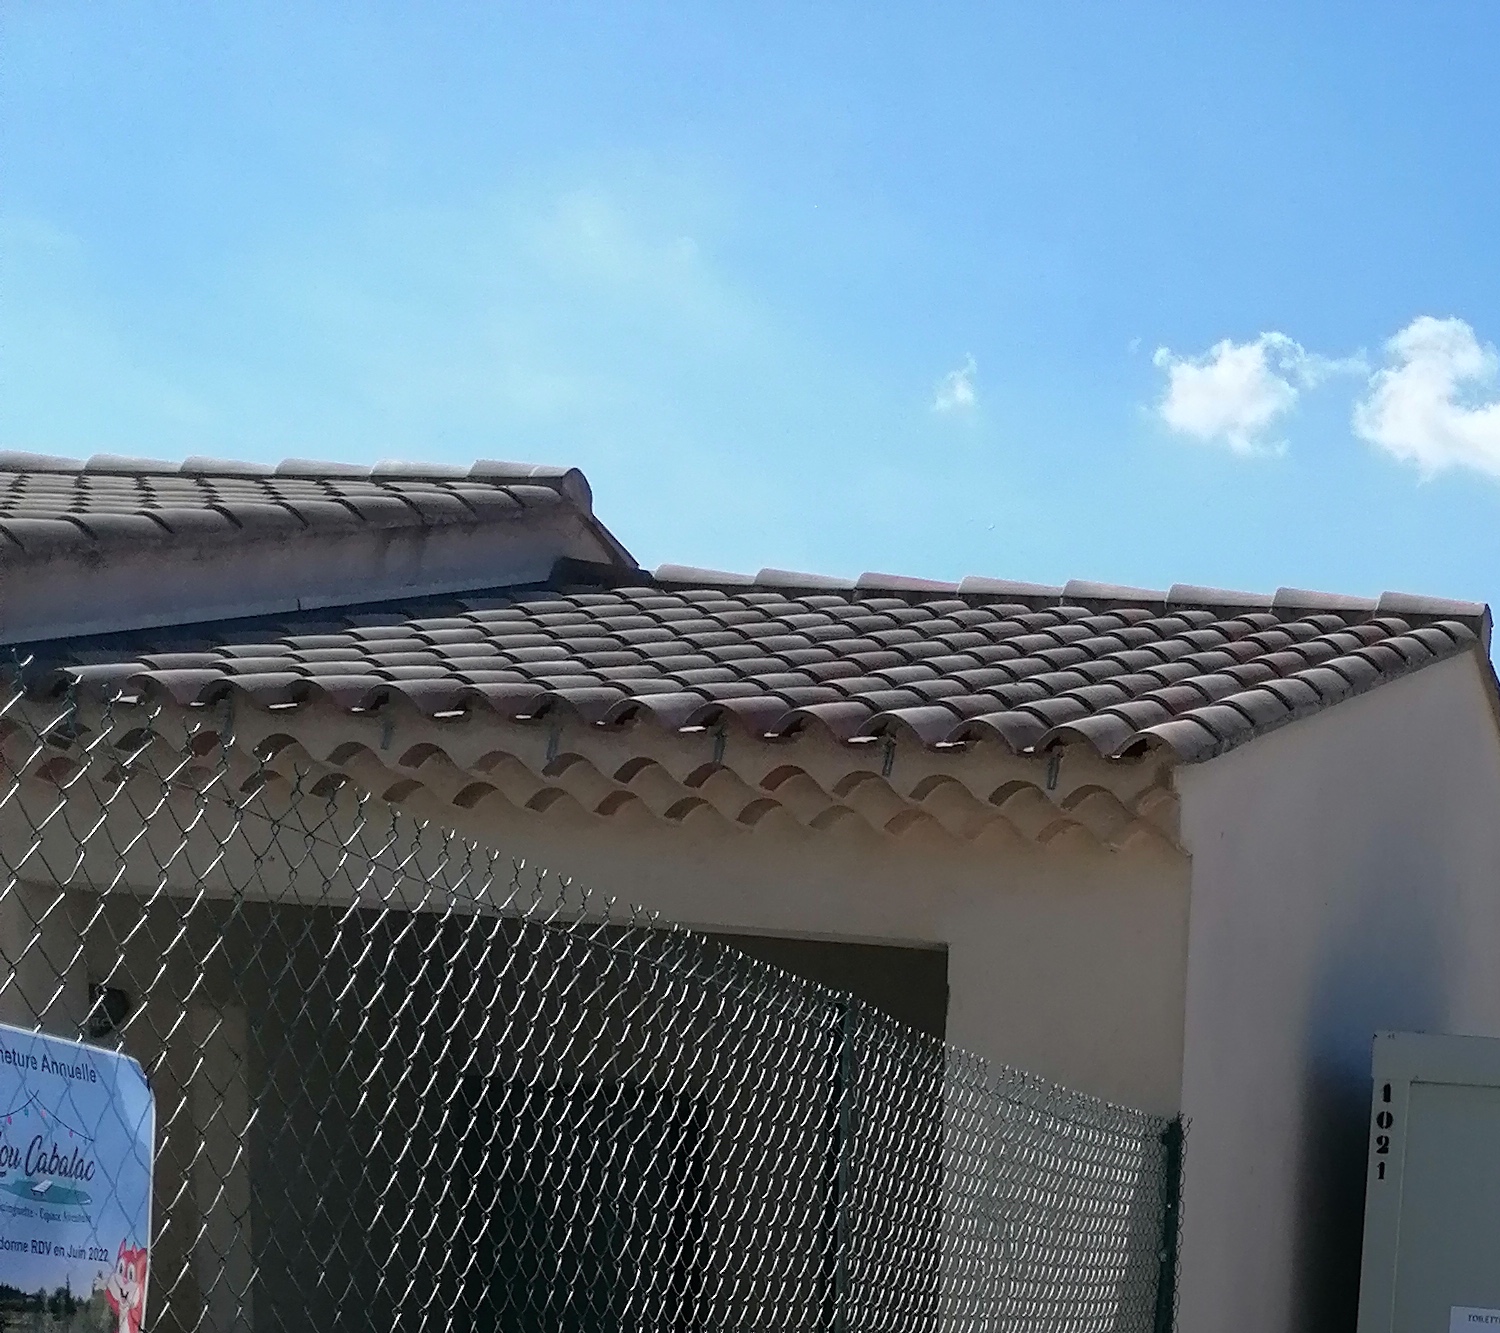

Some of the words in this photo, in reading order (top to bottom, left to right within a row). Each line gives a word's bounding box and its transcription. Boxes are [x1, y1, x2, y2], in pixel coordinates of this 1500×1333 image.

[41, 1053, 97, 1083] Annuelle
[0, 1131, 22, 1178] ou
[31, 1240, 52, 1255] RDV
[54, 1246, 65, 1258] en
[67, 1245, 86, 1260] Juin
[88, 1247, 109, 1262] 2022
